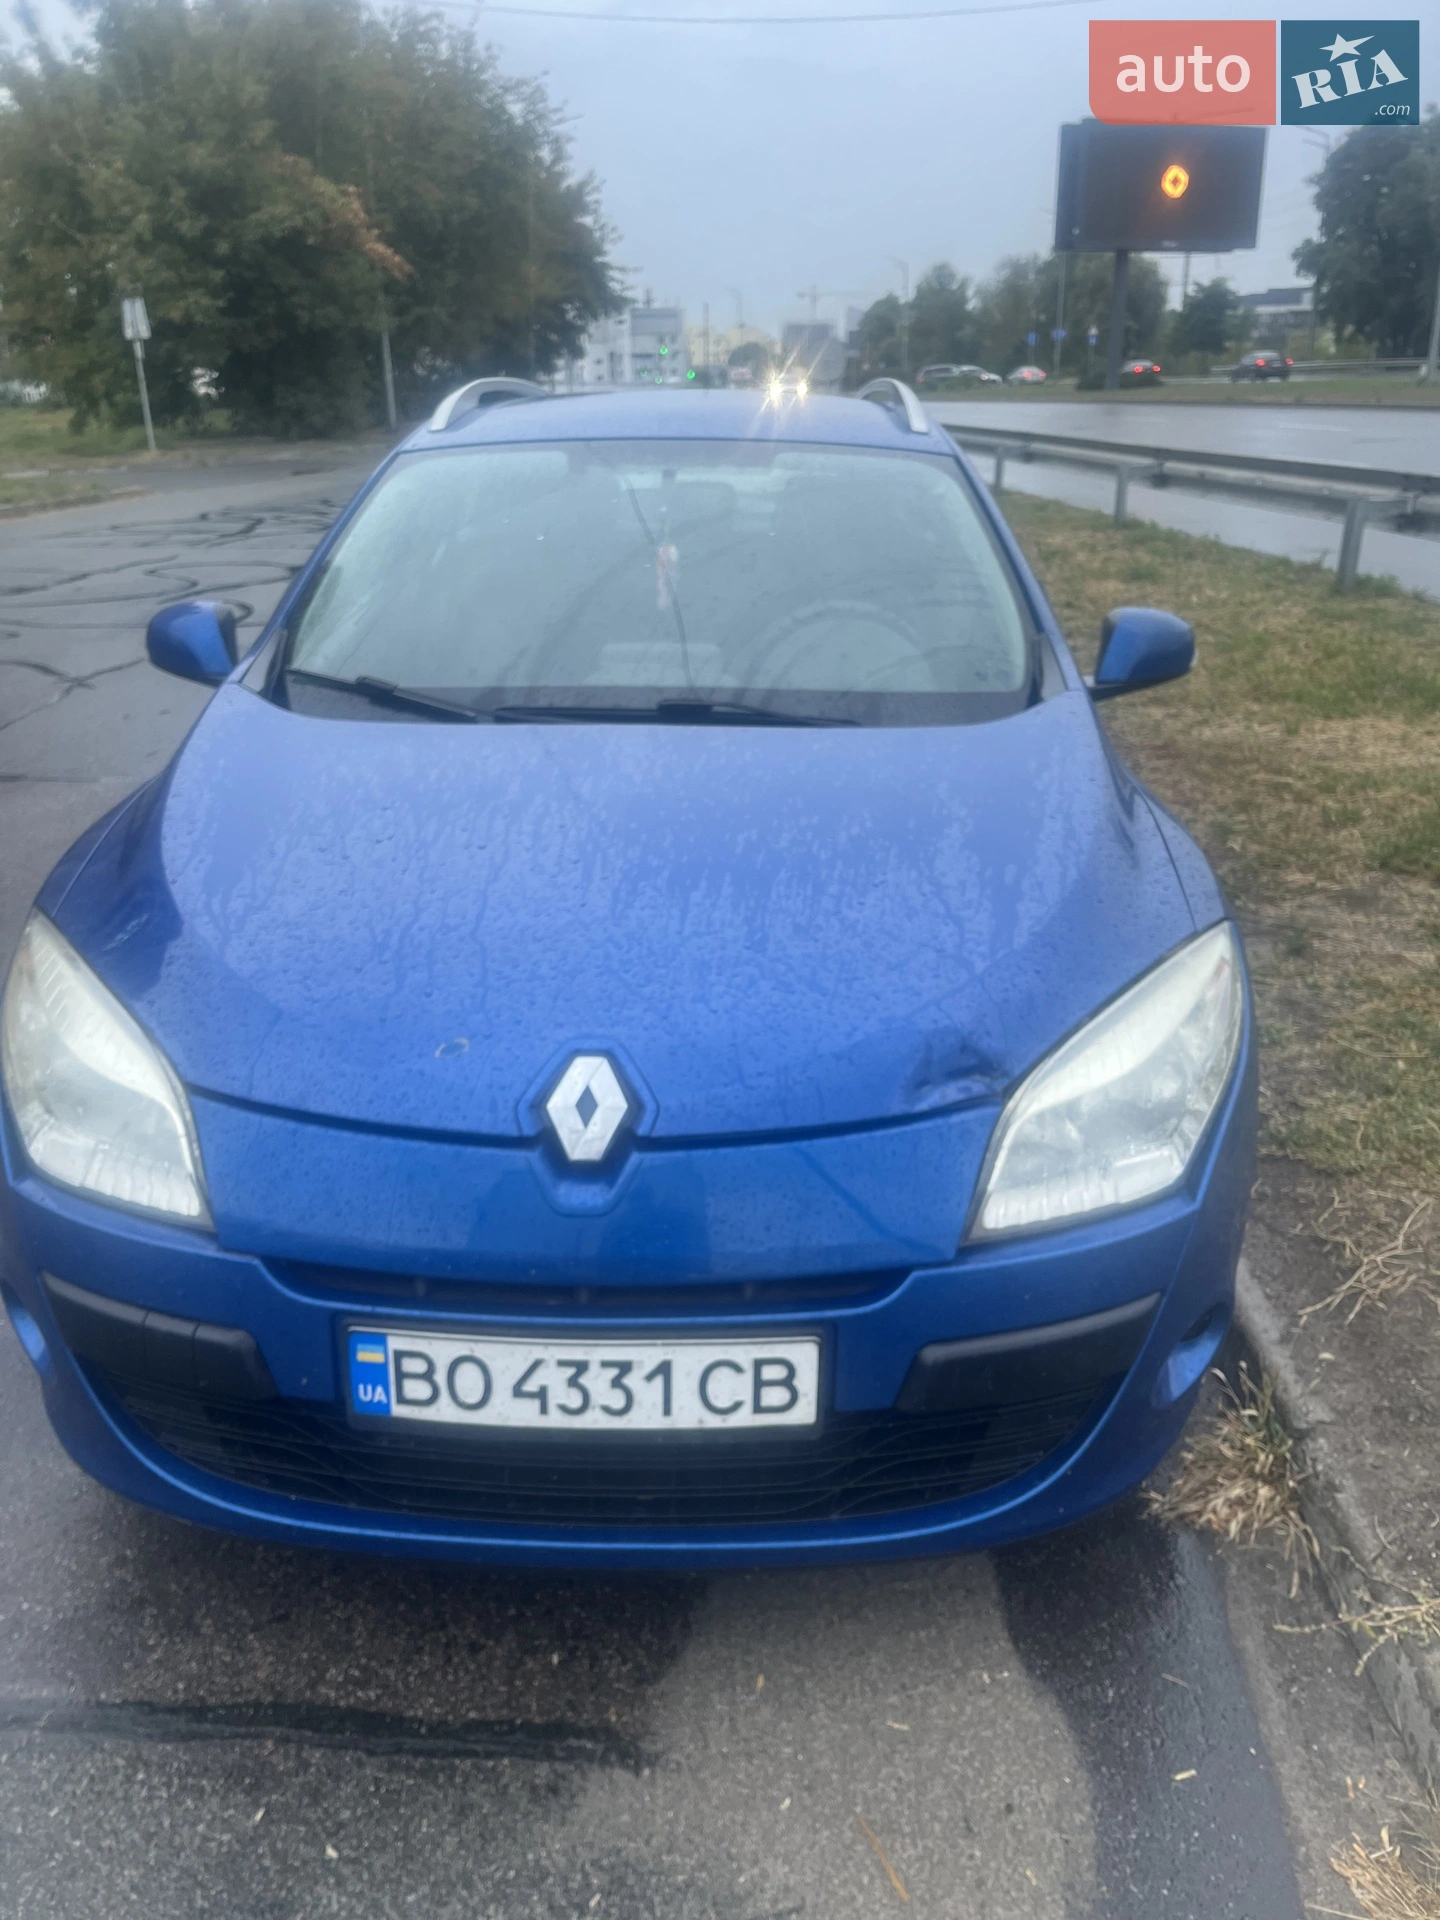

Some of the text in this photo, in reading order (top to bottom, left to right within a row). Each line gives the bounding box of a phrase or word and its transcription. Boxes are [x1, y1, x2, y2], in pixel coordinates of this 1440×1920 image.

[358, 1383, 388, 1404] UA
[393, 1348, 799, 1416] BO 4331 CB
